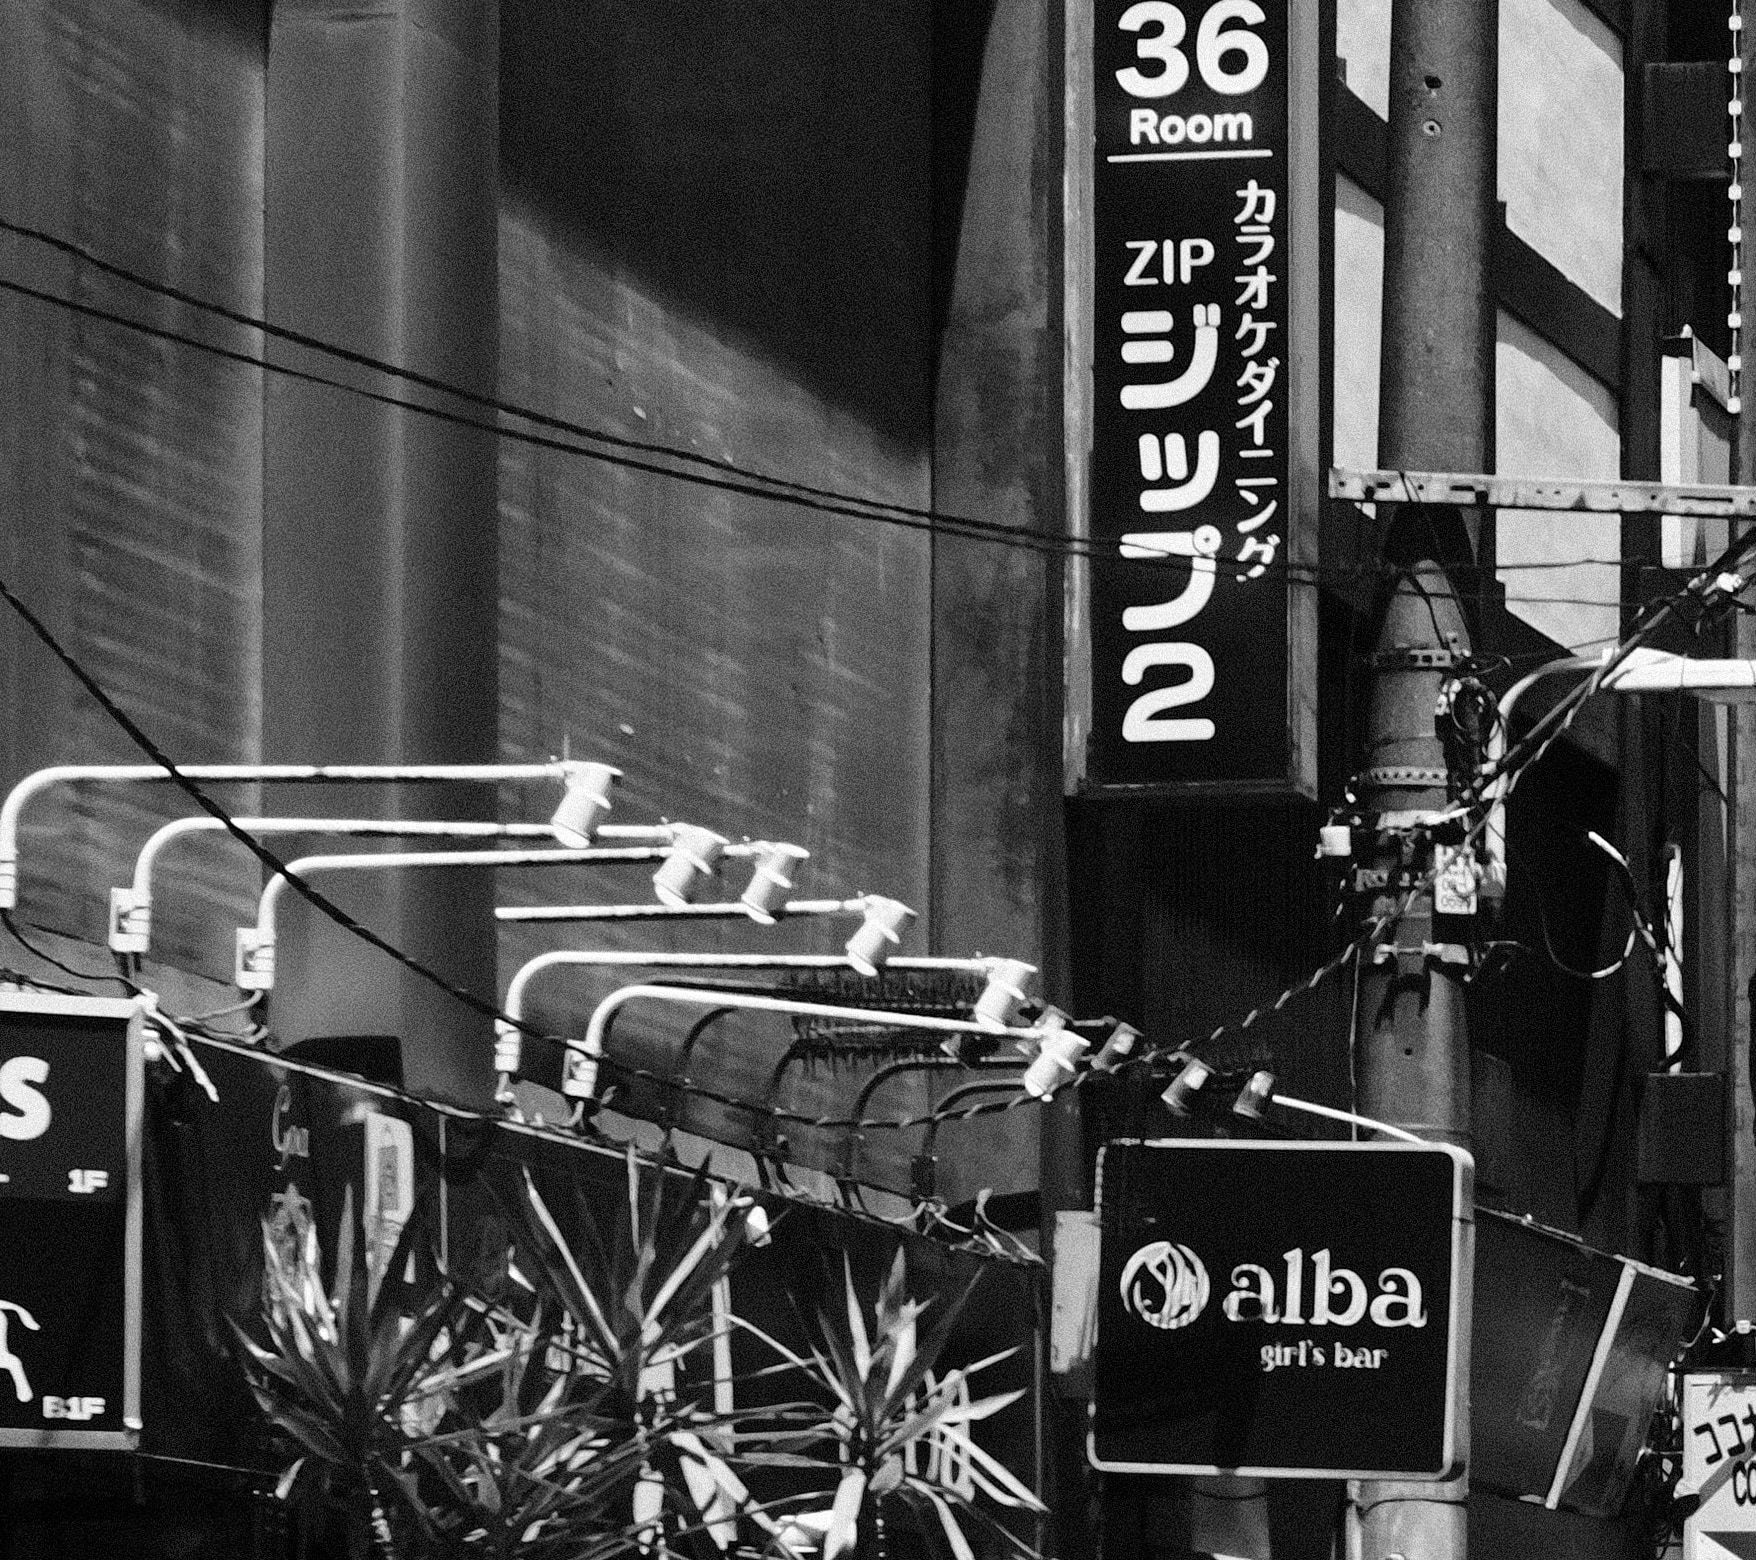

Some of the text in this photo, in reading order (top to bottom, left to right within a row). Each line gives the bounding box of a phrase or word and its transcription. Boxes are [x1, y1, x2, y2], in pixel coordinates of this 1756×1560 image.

[1130, 105, 1253, 146] Room
[1124, 239, 1215, 287] ZIP
[1234, 179, 1281, 583] カラオケダイニング
[68, 1169, 109, 1193] 1F
[1222, 1247, 1428, 1328] alba
[1333, 1341, 1389, 1369] bar
